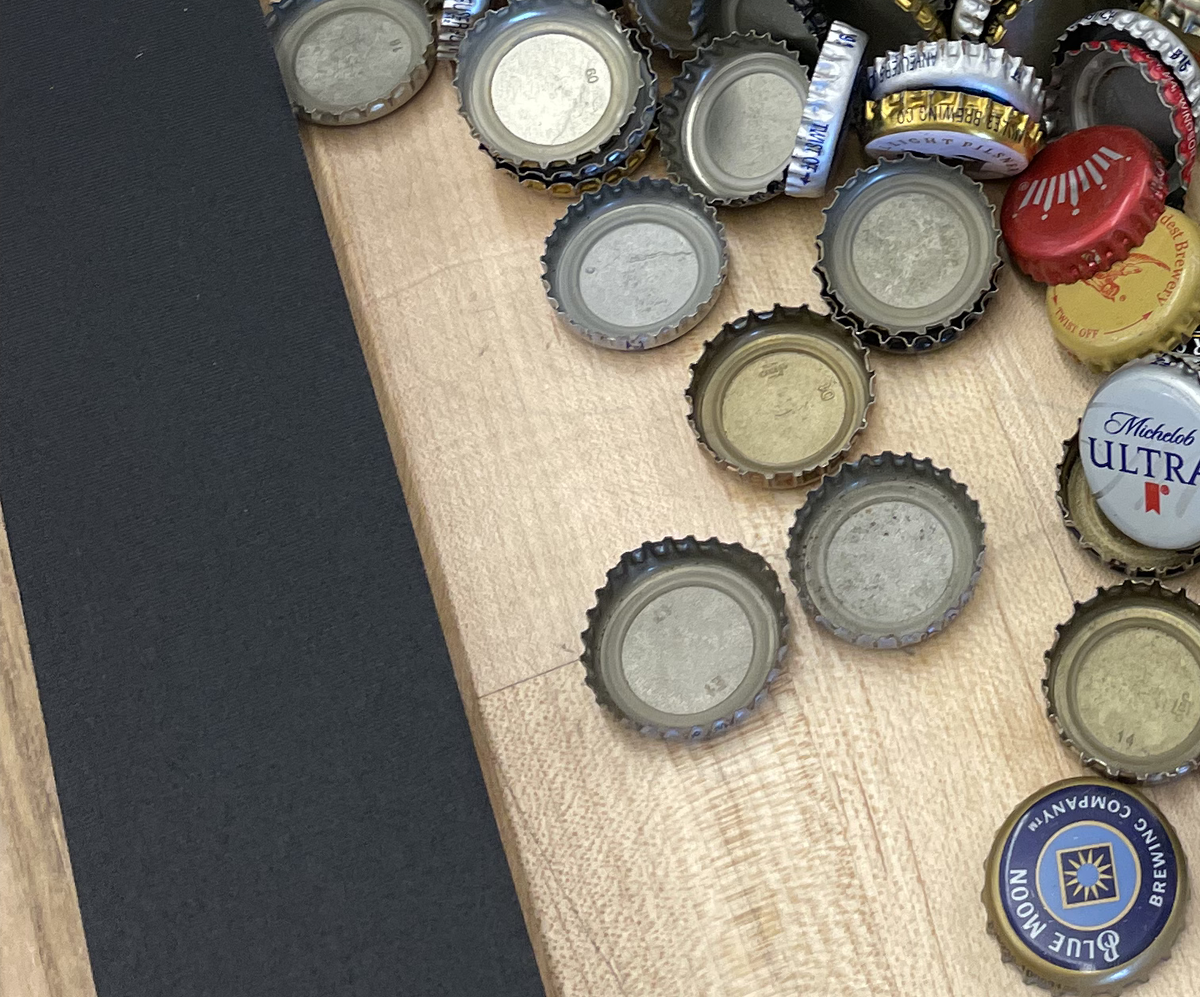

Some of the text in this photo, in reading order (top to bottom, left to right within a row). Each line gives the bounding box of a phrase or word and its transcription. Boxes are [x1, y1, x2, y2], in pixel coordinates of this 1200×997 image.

[810, 121, 829, 157] TWIST
[919, 104, 983, 127] BREWING
[1179, 92, 1199, 151] WINDSO
[1156, 213, 1190, 307] dest Brewery
[1055, 306, 1098, 340] TWIST OFF
[1103, 411, 1199, 447] Michelob
[1132, 817, 1169, 909] BREWING
[1009, 868, 1121, 964] BLUE MOON
